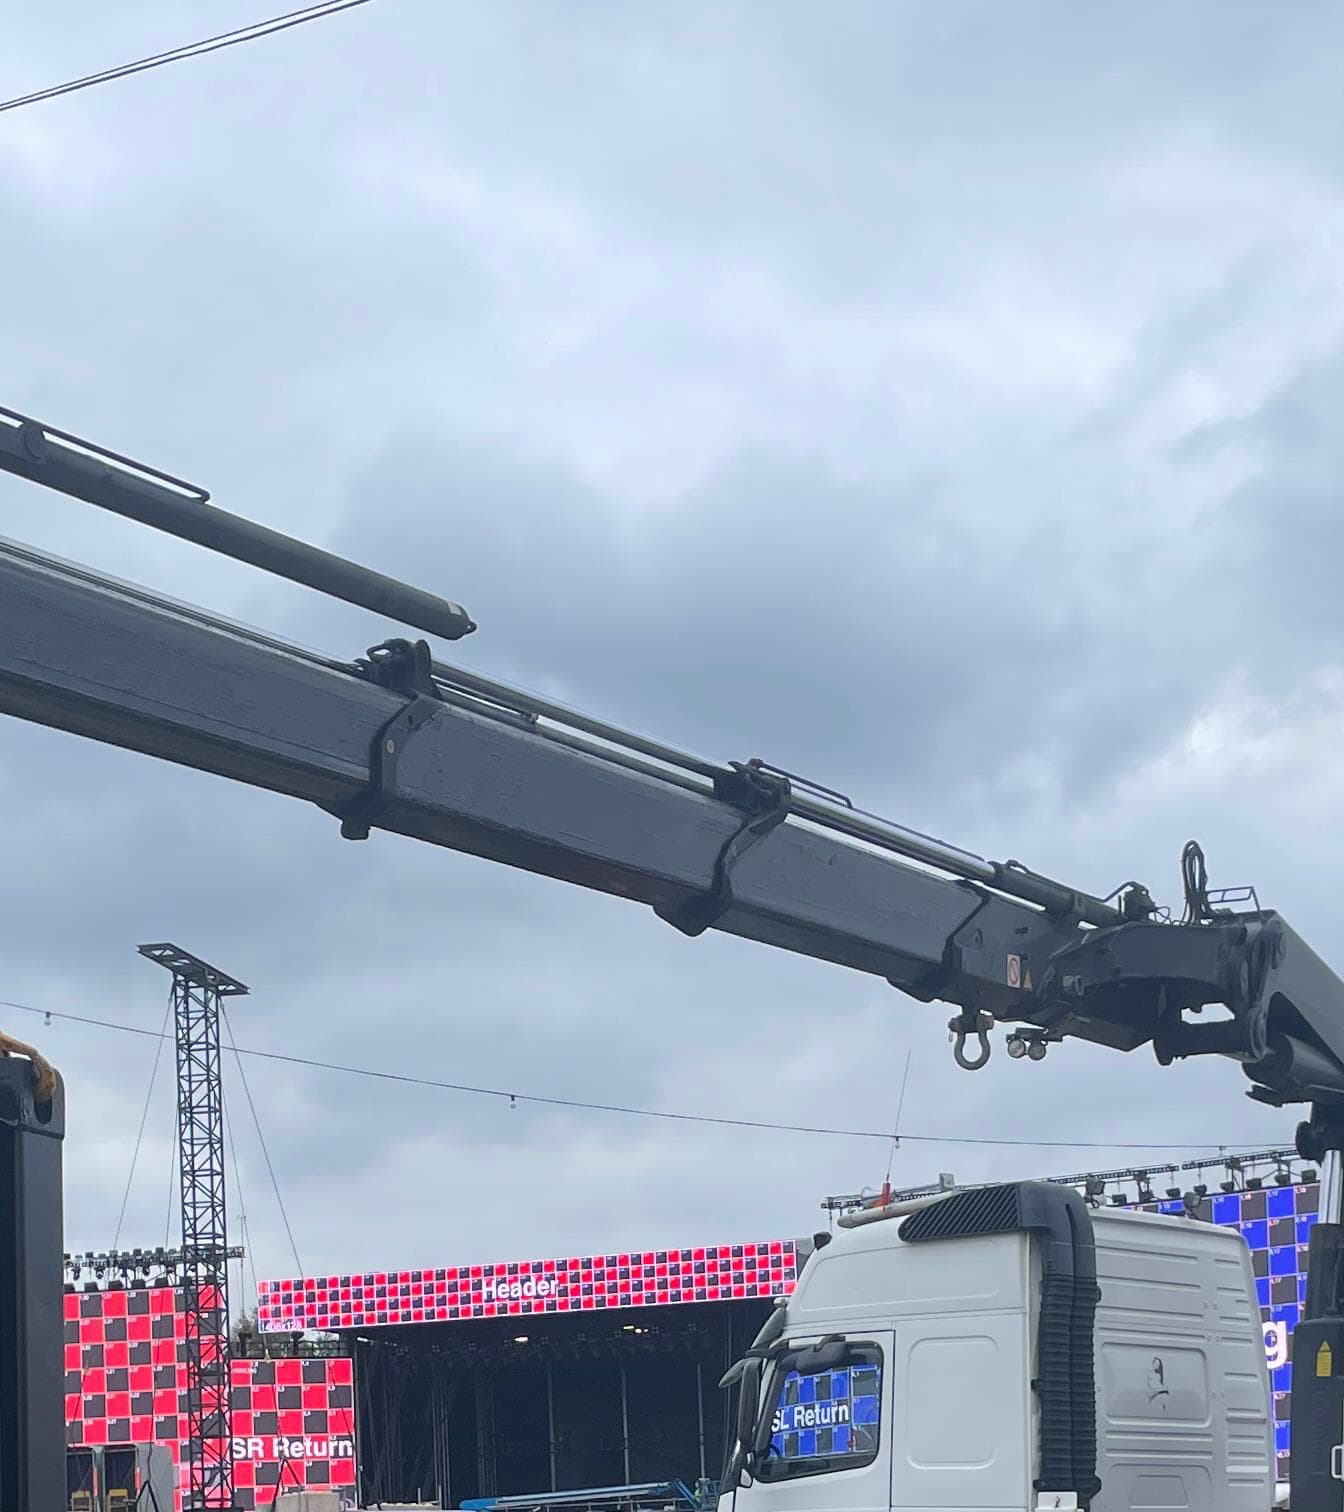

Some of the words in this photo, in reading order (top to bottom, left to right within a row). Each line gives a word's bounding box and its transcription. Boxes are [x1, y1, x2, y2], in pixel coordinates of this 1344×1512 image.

[482, 1274, 558, 1300] Header
[793, 1404, 849, 1428] Return
[232, 1437, 265, 1459] SR
[272, 1436, 353, 1459] Return
